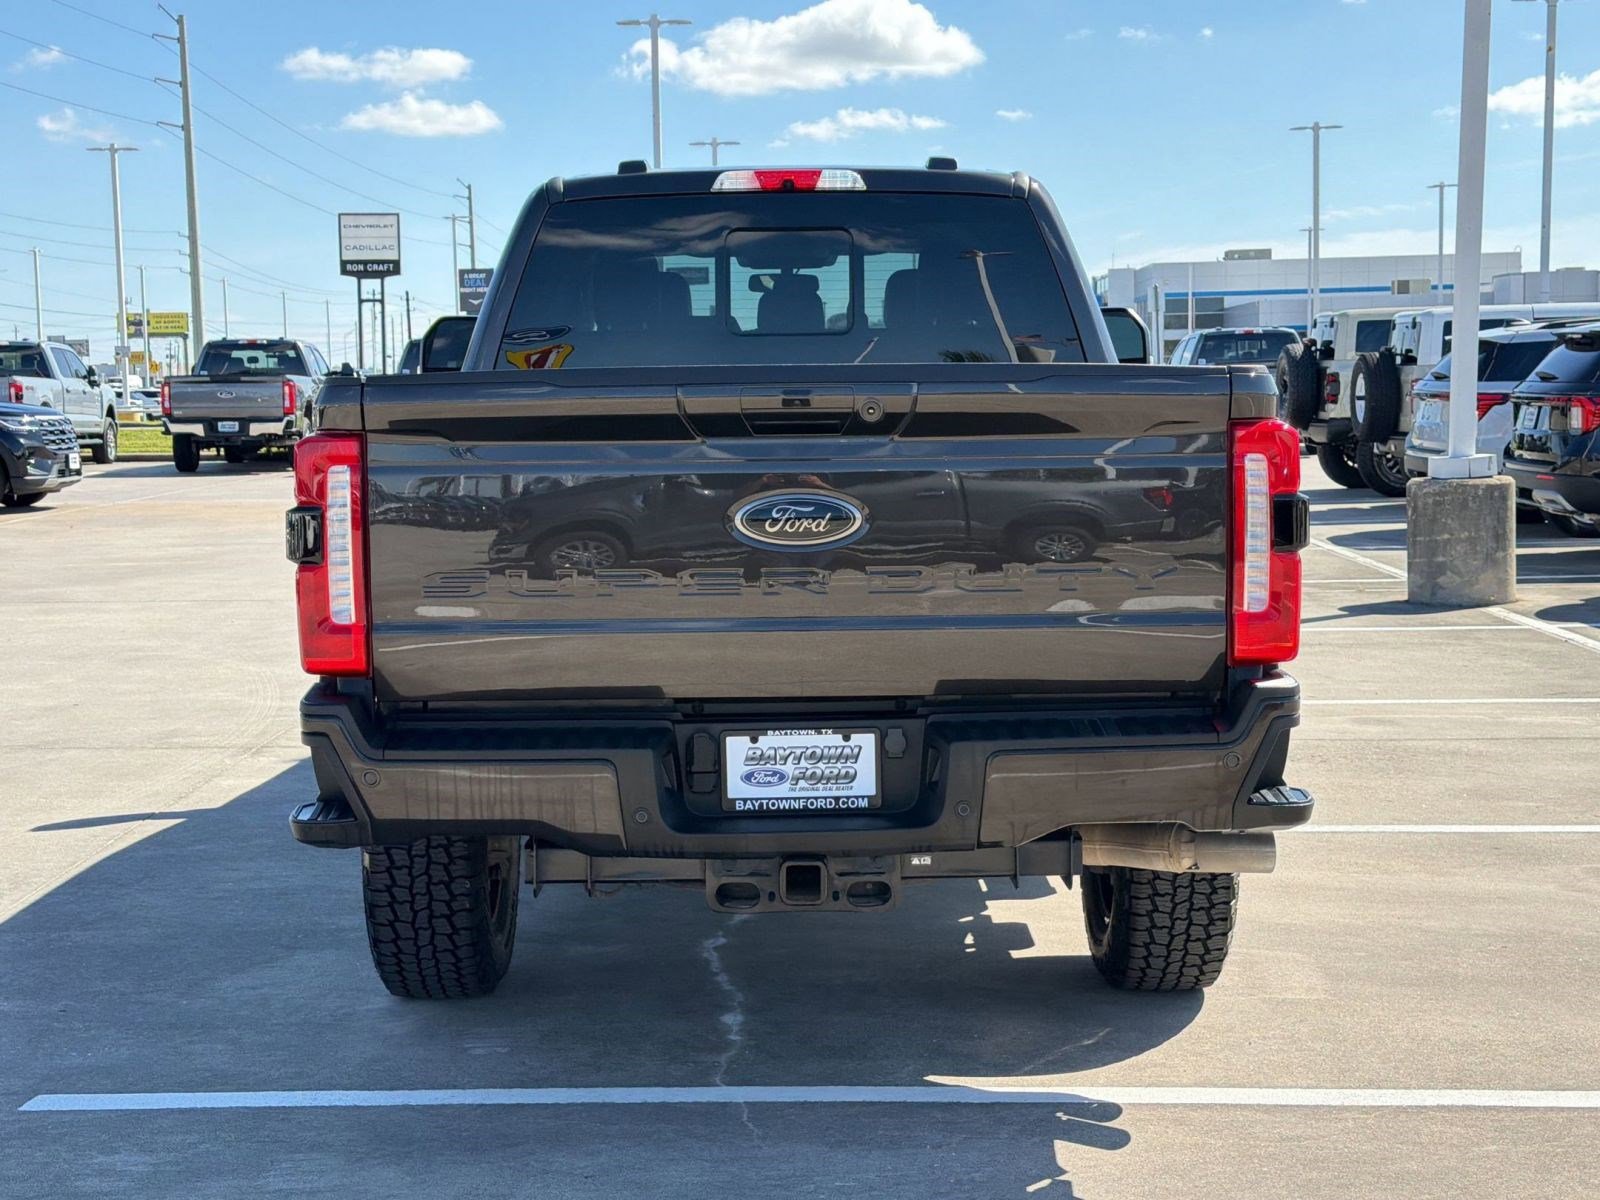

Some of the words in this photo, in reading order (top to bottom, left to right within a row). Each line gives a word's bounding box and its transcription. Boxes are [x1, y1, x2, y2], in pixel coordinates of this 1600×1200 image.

[346, 263, 364, 271] RON
[367, 263, 394, 271] CRAFT
[464, 279, 486, 287] DEAL
[765, 505, 831, 533] Ford
[422, 568, 831, 598] SUPER
[864, 563, 1178, 594] DUTY
[744, 745, 862, 766] BAYTOWN
[750, 771, 780, 784] Ford
[789, 766, 858, 786] FORD
[735, 798, 869, 811] BAYTOWNFORD.COM
